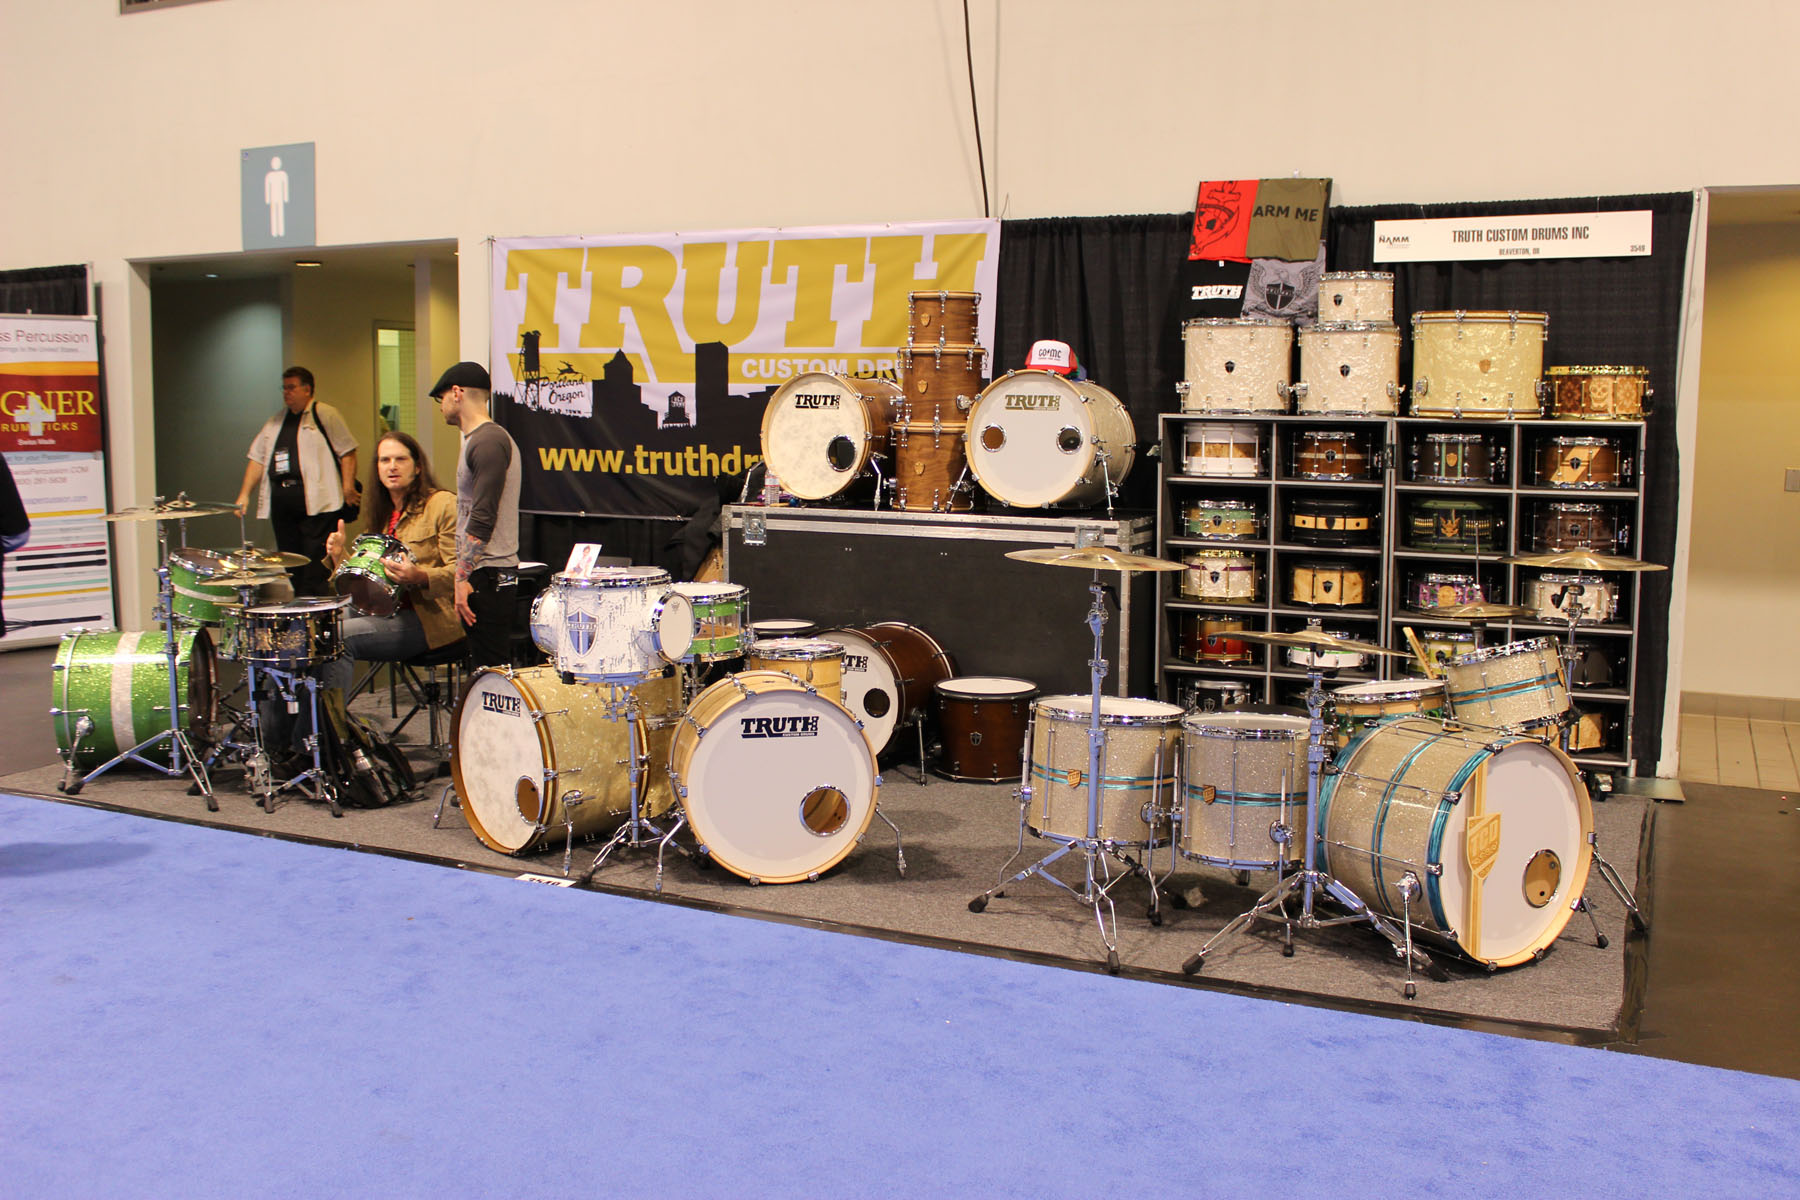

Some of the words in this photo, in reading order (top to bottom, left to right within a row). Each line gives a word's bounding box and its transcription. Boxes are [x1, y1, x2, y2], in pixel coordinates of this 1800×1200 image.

[1252, 204, 1291, 218] ARM
[1294, 207, 1320, 222] ME
[1452, 229, 1483, 243] TRUTH
[1486, 228, 1529, 243] CUSTOM
[1531, 227, 1569, 241] DRUMS
[1571, 226, 1590, 240] INC
[1499, 248, 1531, 256] BEAVERTON,
[1532, 247, 1540, 255] OR
[505, 233, 988, 350] TRUTH
[1191, 285, 1243, 300] TRUTH
[16, 329, 89, 343] Percussion
[741, 358, 849, 379] CUSTOM
[540, 376, 585, 391] Portland
[548, 390, 585, 405] Oregon
[795, 394, 841, 409] TRUTH
[1004, 394, 1061, 411] TRUTH
[1, 422, 79, 432] RUMTICKS
[538, 444, 765, 477] www.truthdr
[482, 691, 521, 713] TRUTH
[741, 716, 819, 737] TRUTH
[1470, 819, 1499, 857] TCD
